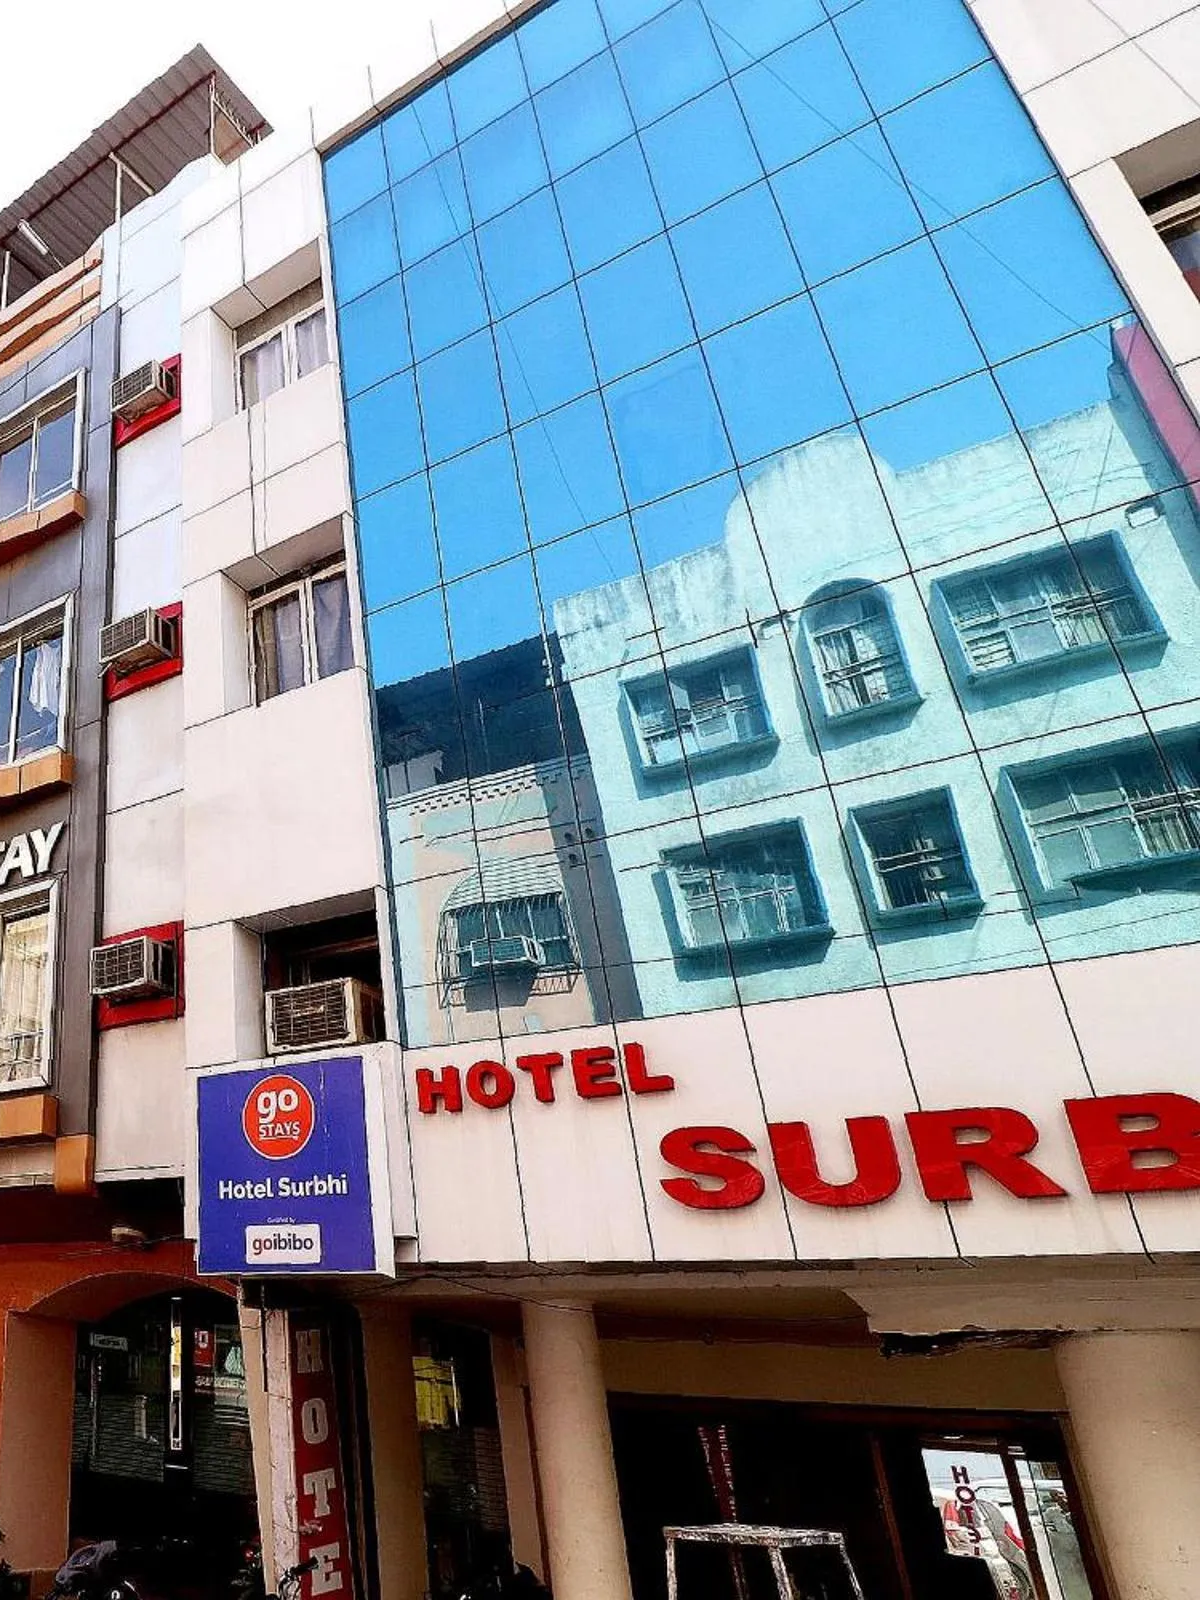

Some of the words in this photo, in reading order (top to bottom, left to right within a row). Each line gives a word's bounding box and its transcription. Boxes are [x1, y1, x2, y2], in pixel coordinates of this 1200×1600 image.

[416, 1042, 675, 1115] HOTEL
[256, 1088, 300, 1124] go
[258, 1121, 301, 1139] STAYS
[659, 1091, 1200, 1211] SURB
[218, 1177, 275, 1200] Hotel
[277, 1173, 349, 1198] Surbhi
[252, 1233, 315, 1256] goibibo
